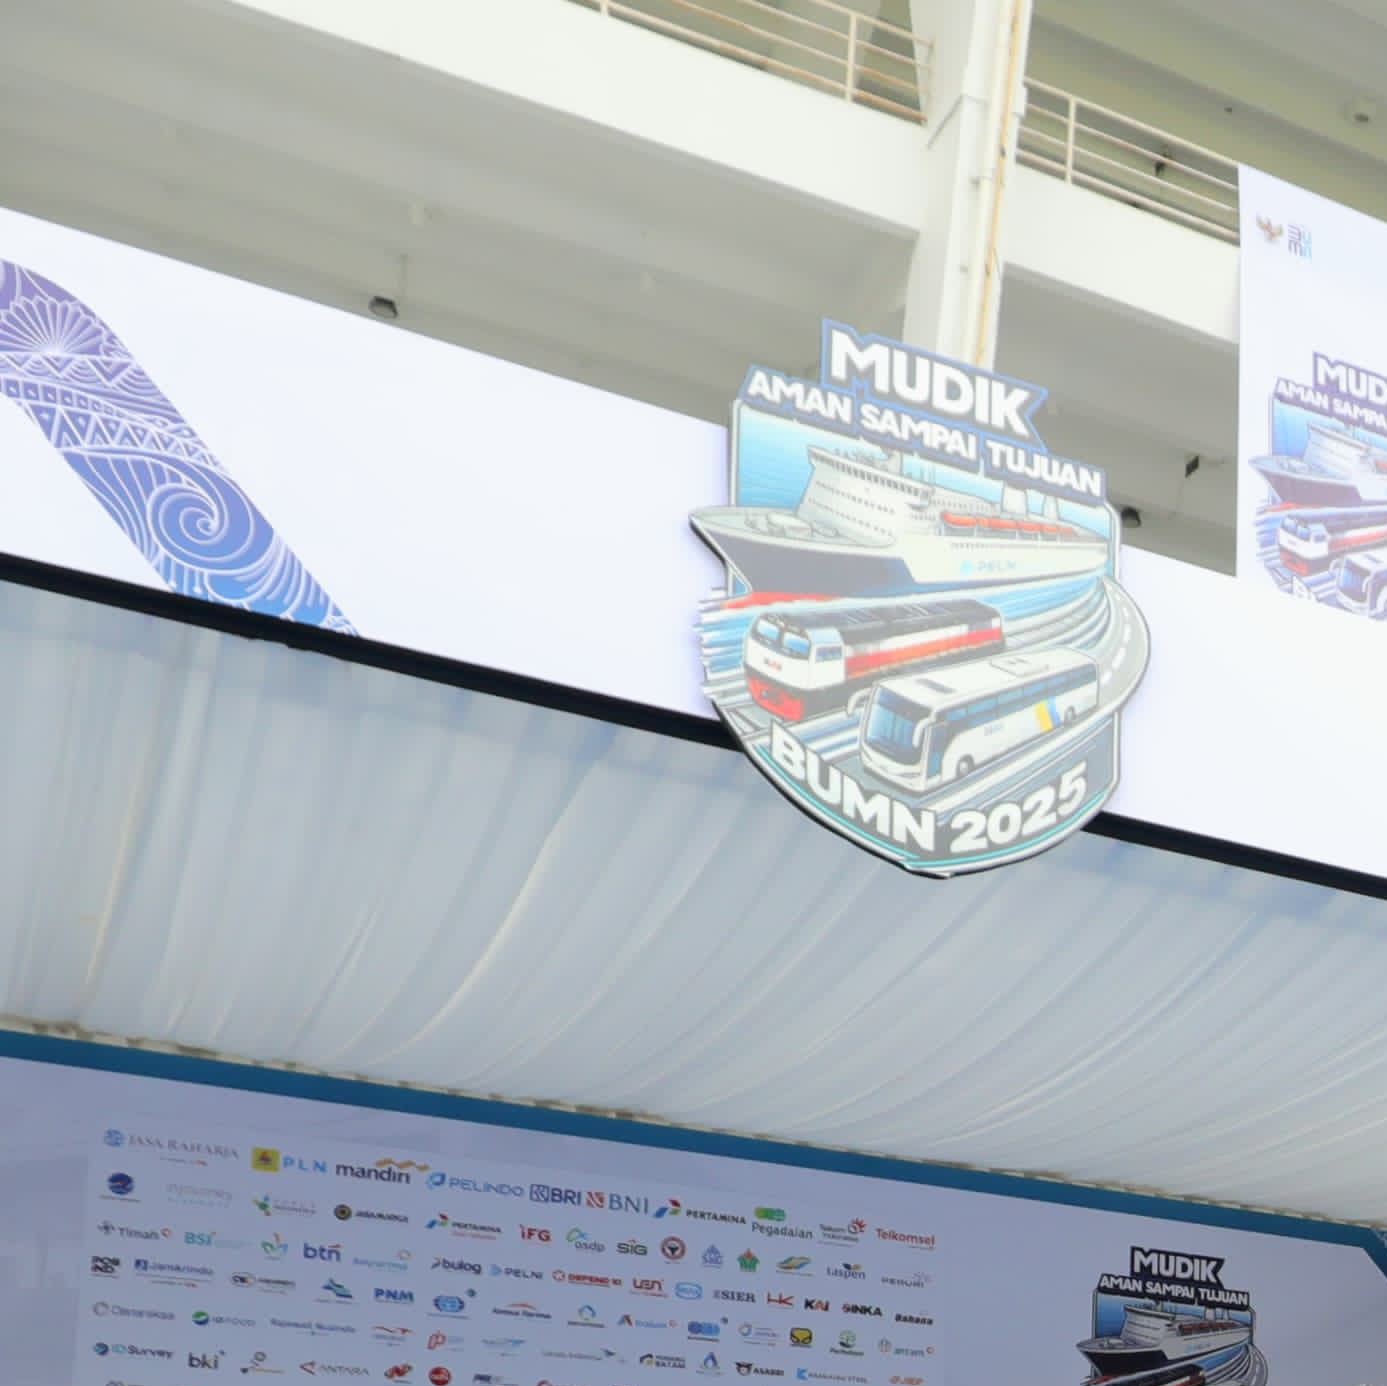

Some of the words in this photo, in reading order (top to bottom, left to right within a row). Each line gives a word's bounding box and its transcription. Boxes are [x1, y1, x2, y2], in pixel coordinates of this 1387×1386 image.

[830, 328, 1032, 438] MUDIK
[1278, 378, 1330, 410] AMAN
[747, 369, 853, 425] AMAN
[859, 402, 977, 461] SAMPAI
[985, 438, 1102, 498] TUJUAN
[770, 723, 937, 852] BUMN
[948, 760, 1090, 854] 2025
[282, 1156, 328, 1173] PLN
[551, 1187, 582, 1206] BRI
[608, 1193, 649, 1215] BNI
[686, 1208, 747, 1225] PERTAMINA
[184, 1231, 213, 1246] BSI
[751, 1220, 814, 1240] Pegadaian
[874, 1226, 936, 1247] Telkomsel
[303, 1242, 343, 1263] btn
[442, 1258, 483, 1276] bulog
[1133, 1250, 1218, 1283] MUDIK
[373, 1287, 415, 1303] PNM
[1100, 1275, 1143, 1294] AMAN
[1145, 1280, 1195, 1300] SAMPAI
[1199, 1287, 1250, 1307] TUJUAN
[188, 1352, 219, 1370] bki
